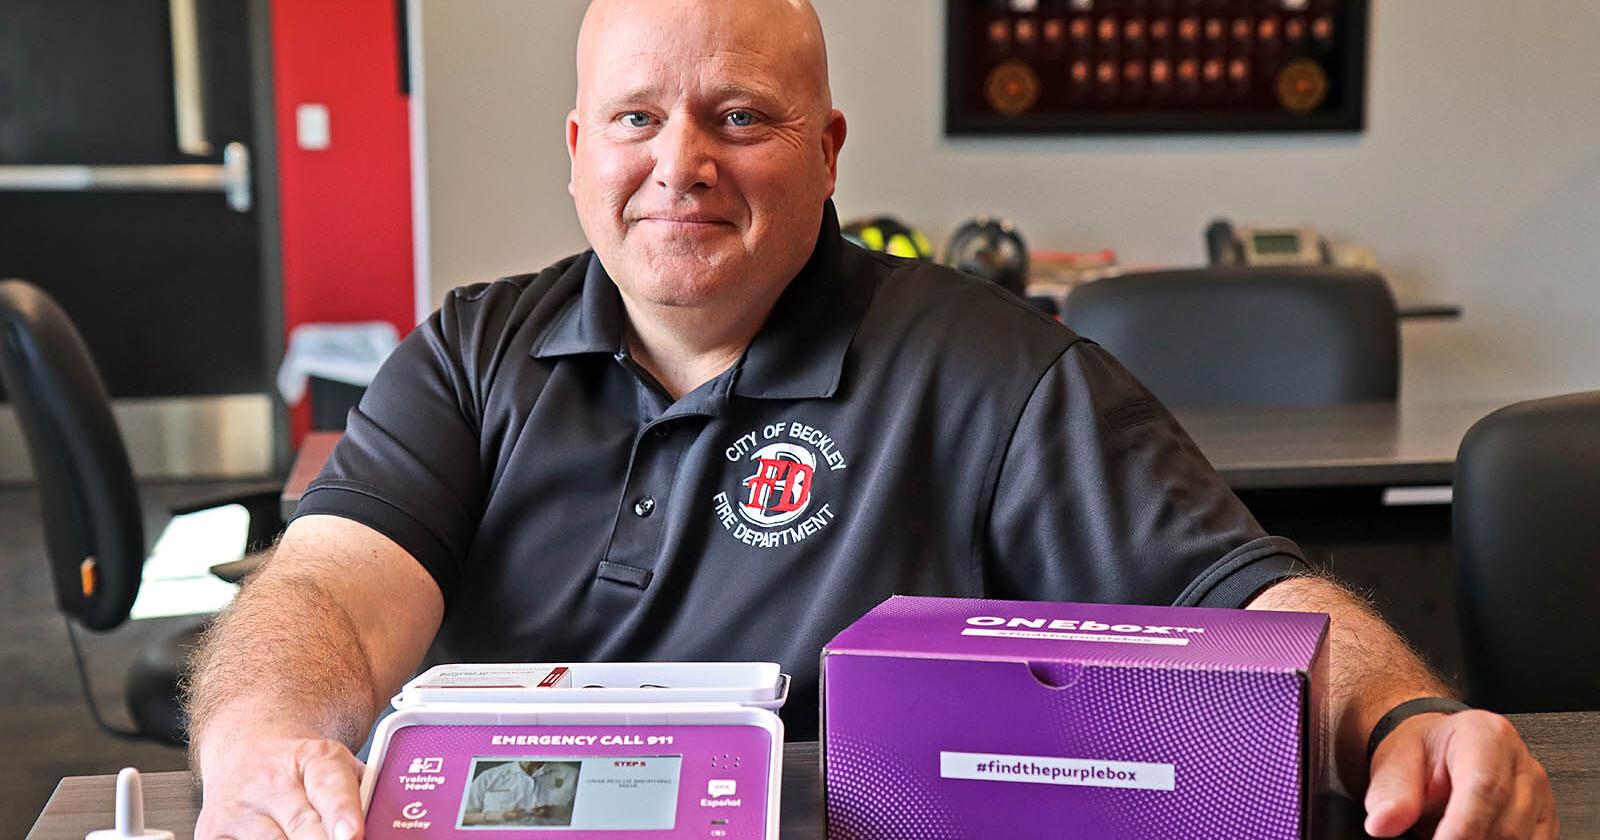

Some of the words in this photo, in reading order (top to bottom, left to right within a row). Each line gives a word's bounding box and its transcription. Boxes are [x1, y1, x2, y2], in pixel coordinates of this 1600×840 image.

[725, 431, 757, 462] CITY
[763, 422, 786, 440] OF
[789, 422, 847, 472] BECKLEY
[712, 491, 738, 530] FIRE
[733, 503, 835, 548] DEPARTMENT
[491, 735, 598, 746] EMERGENCY
[600, 735, 644, 746] CALL
[646, 735, 674, 745] 911
[976, 759, 1137, 782] #findthepurplebox
[399, 774, 446, 785] Training
[404, 783, 436, 791] Mode
[700, 798, 742, 808] Español
[392, 820, 432, 830] Replay
